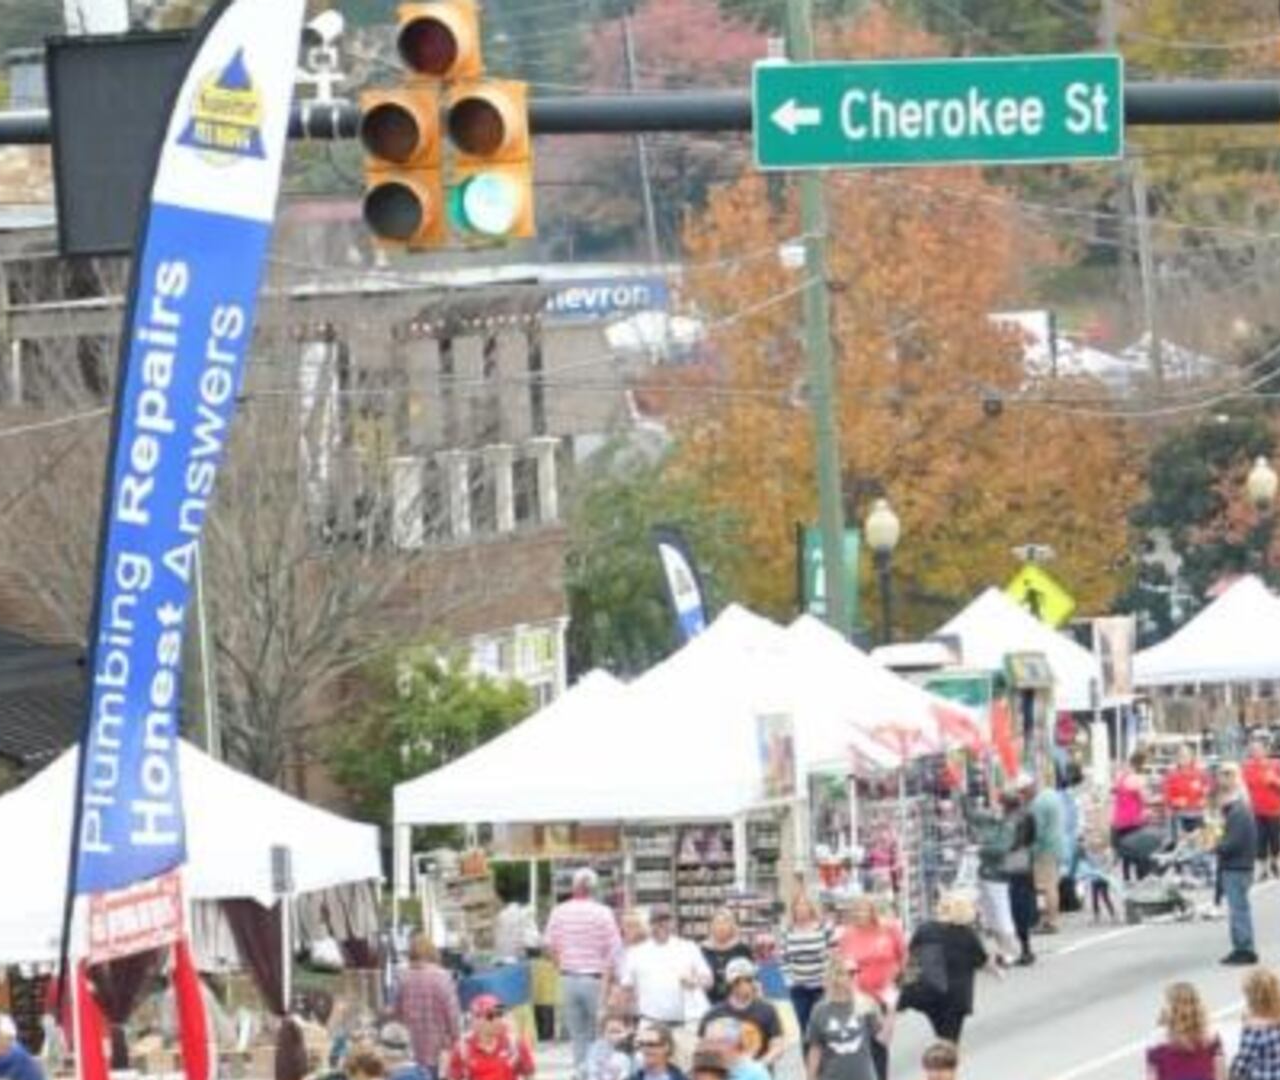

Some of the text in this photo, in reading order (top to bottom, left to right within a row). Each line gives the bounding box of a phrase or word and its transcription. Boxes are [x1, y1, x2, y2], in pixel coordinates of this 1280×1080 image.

[839, 82, 1110, 140] Cherokee St
[115, 260, 190, 525] Repairs
[546, 282, 652, 311] hevron
[81, 552, 154, 854] Plumbing
[131, 602, 184, 846] Honest
[162, 304, 245, 584] Answers
